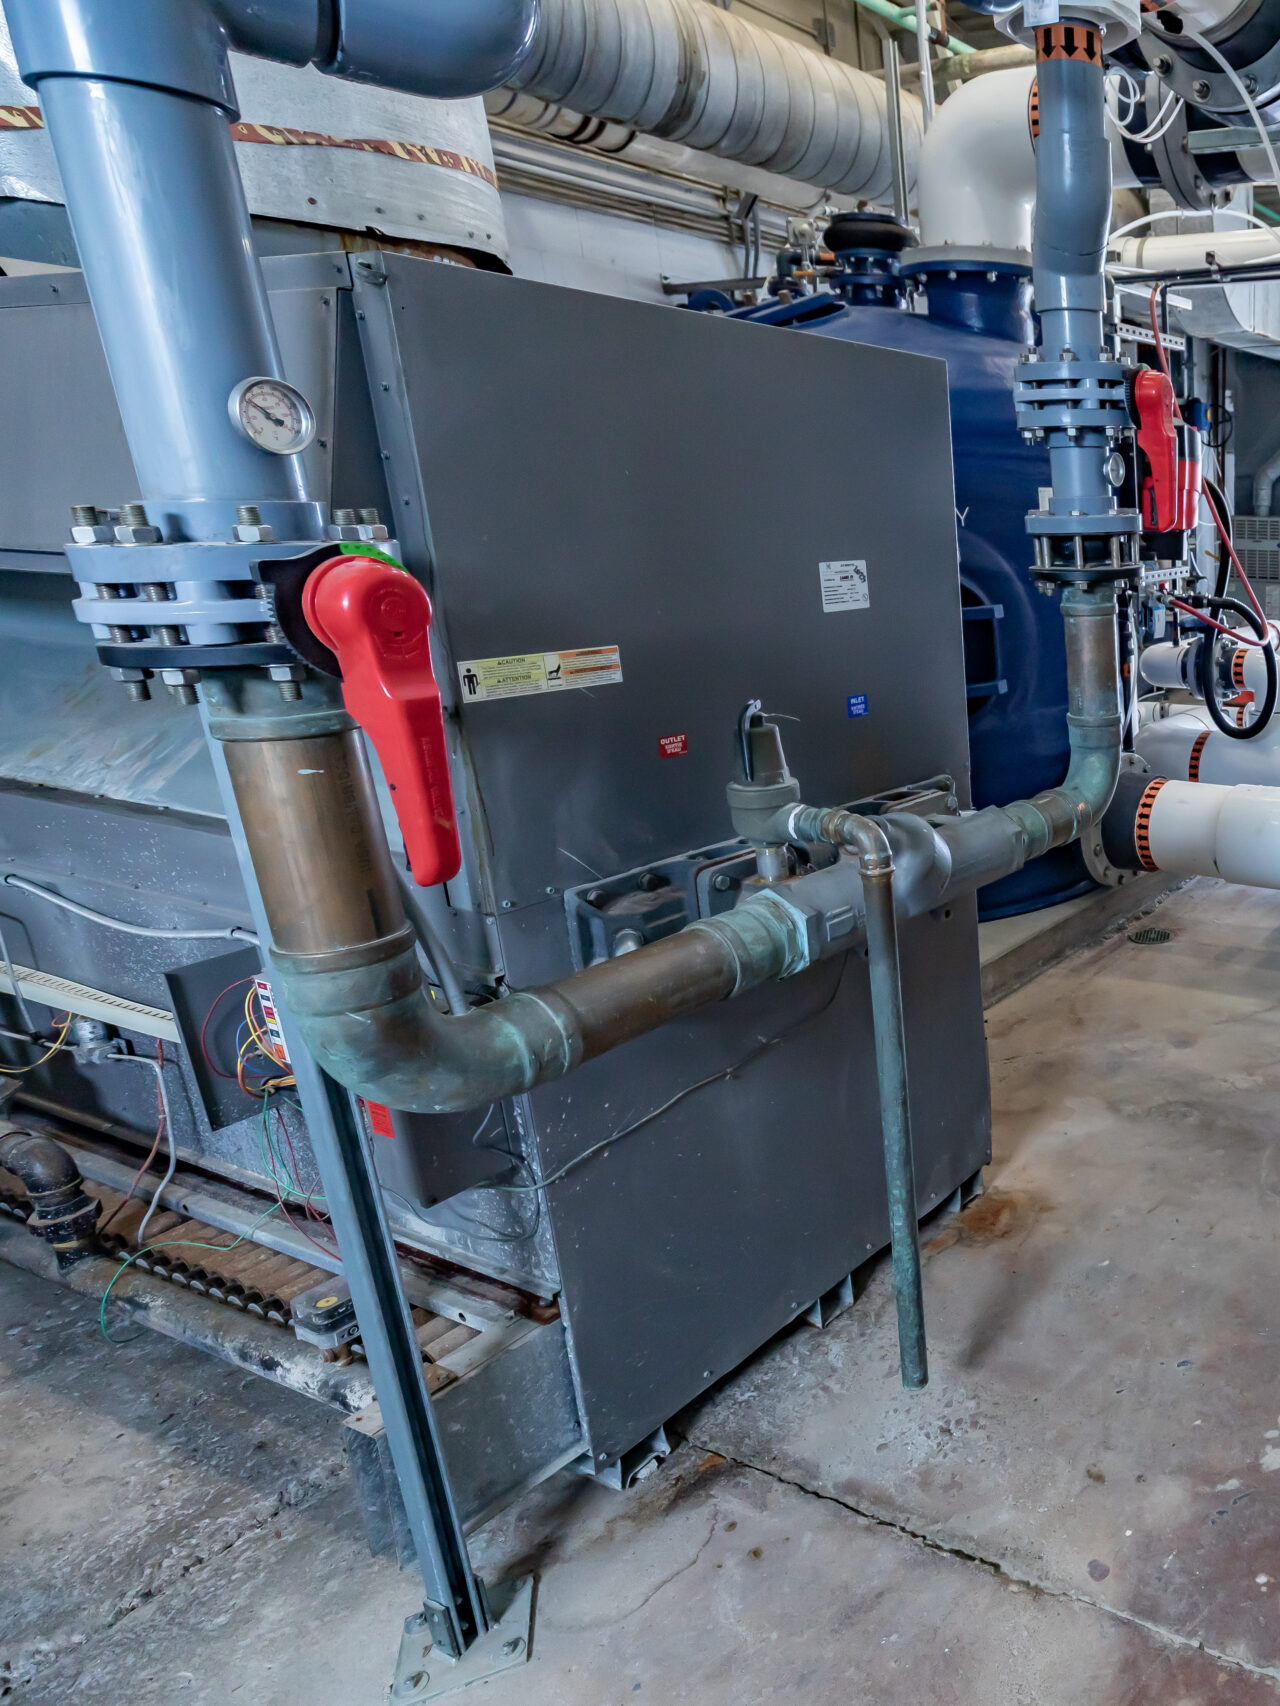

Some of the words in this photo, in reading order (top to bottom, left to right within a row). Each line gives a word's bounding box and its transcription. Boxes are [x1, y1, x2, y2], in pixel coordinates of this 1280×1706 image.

[501, 657, 526, 666] CAUTION
[501, 674, 532, 683] ATTENTION
[660, 734, 686, 745] OUTLET
